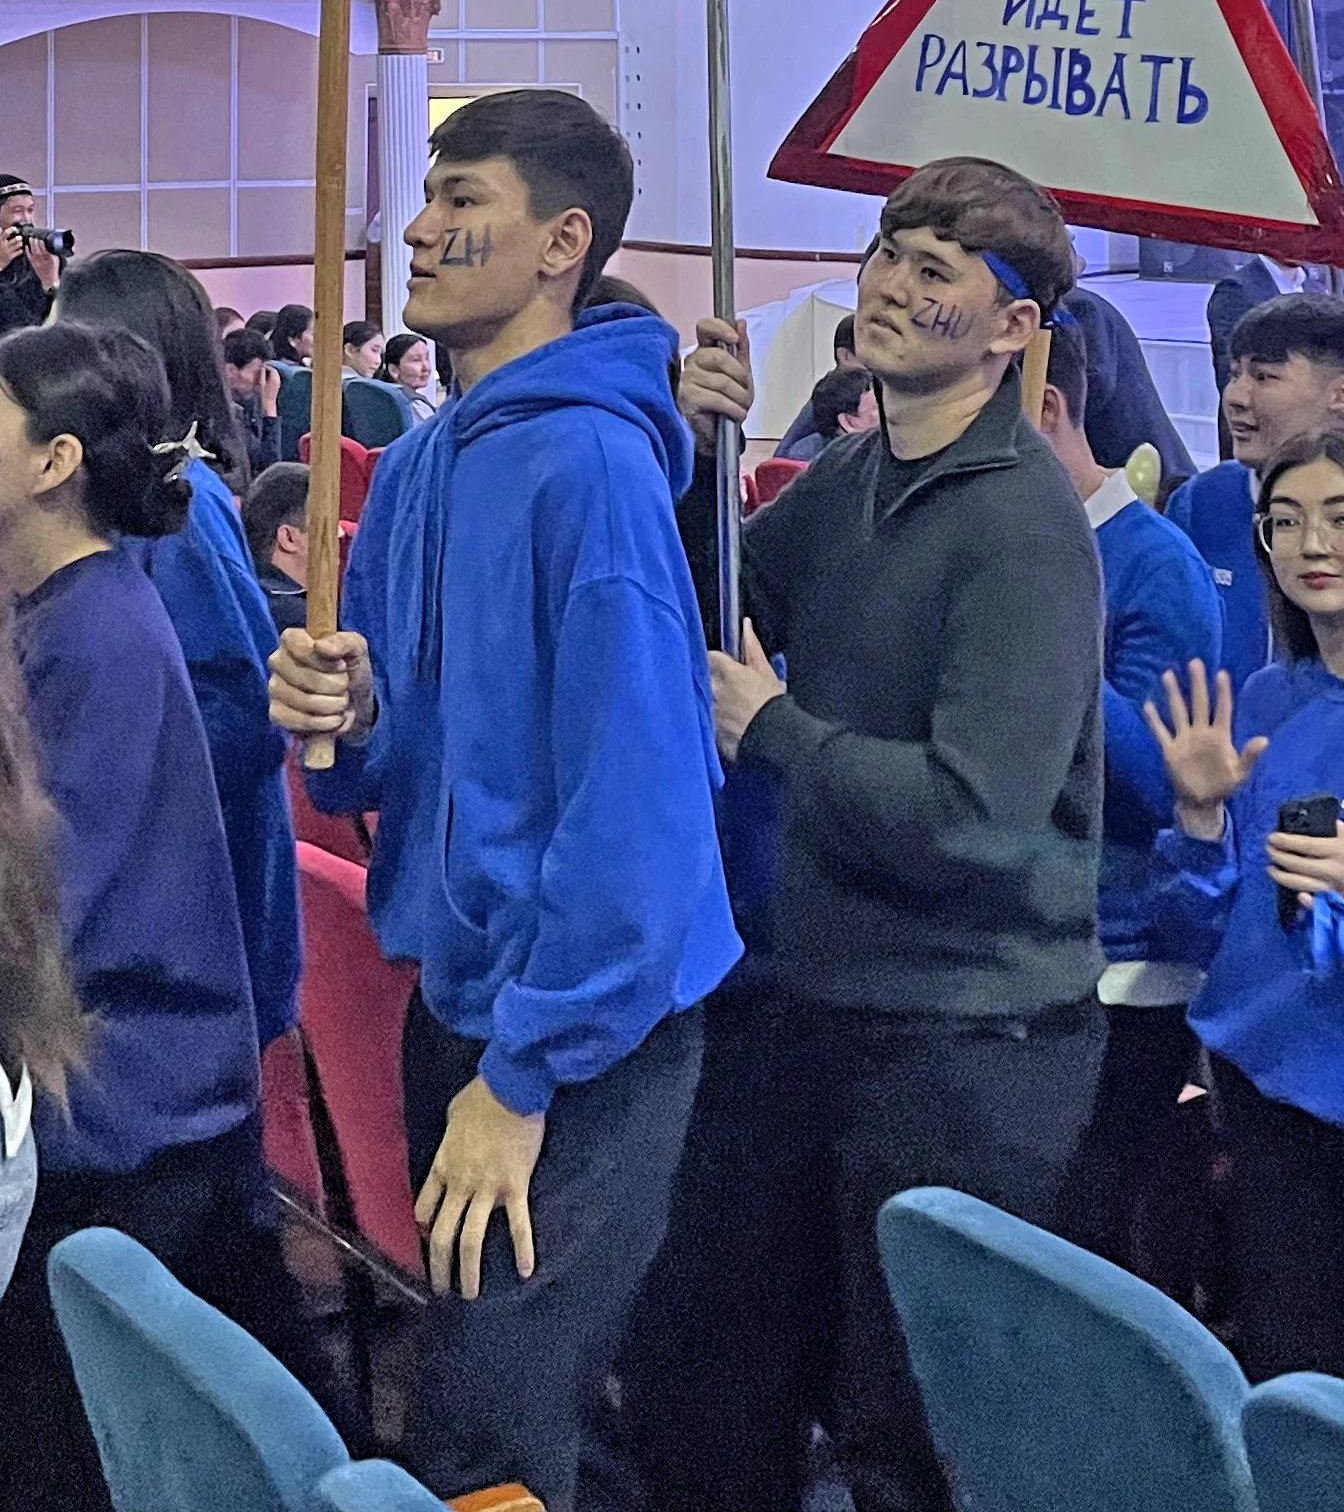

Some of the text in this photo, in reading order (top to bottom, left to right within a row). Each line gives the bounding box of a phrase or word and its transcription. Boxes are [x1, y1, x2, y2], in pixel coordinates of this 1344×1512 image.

[915, 33, 1209, 125] РАЗРЫВАТЬ
[439, 222, 494, 268] ZH
[911, 297, 974, 338] ZHU
